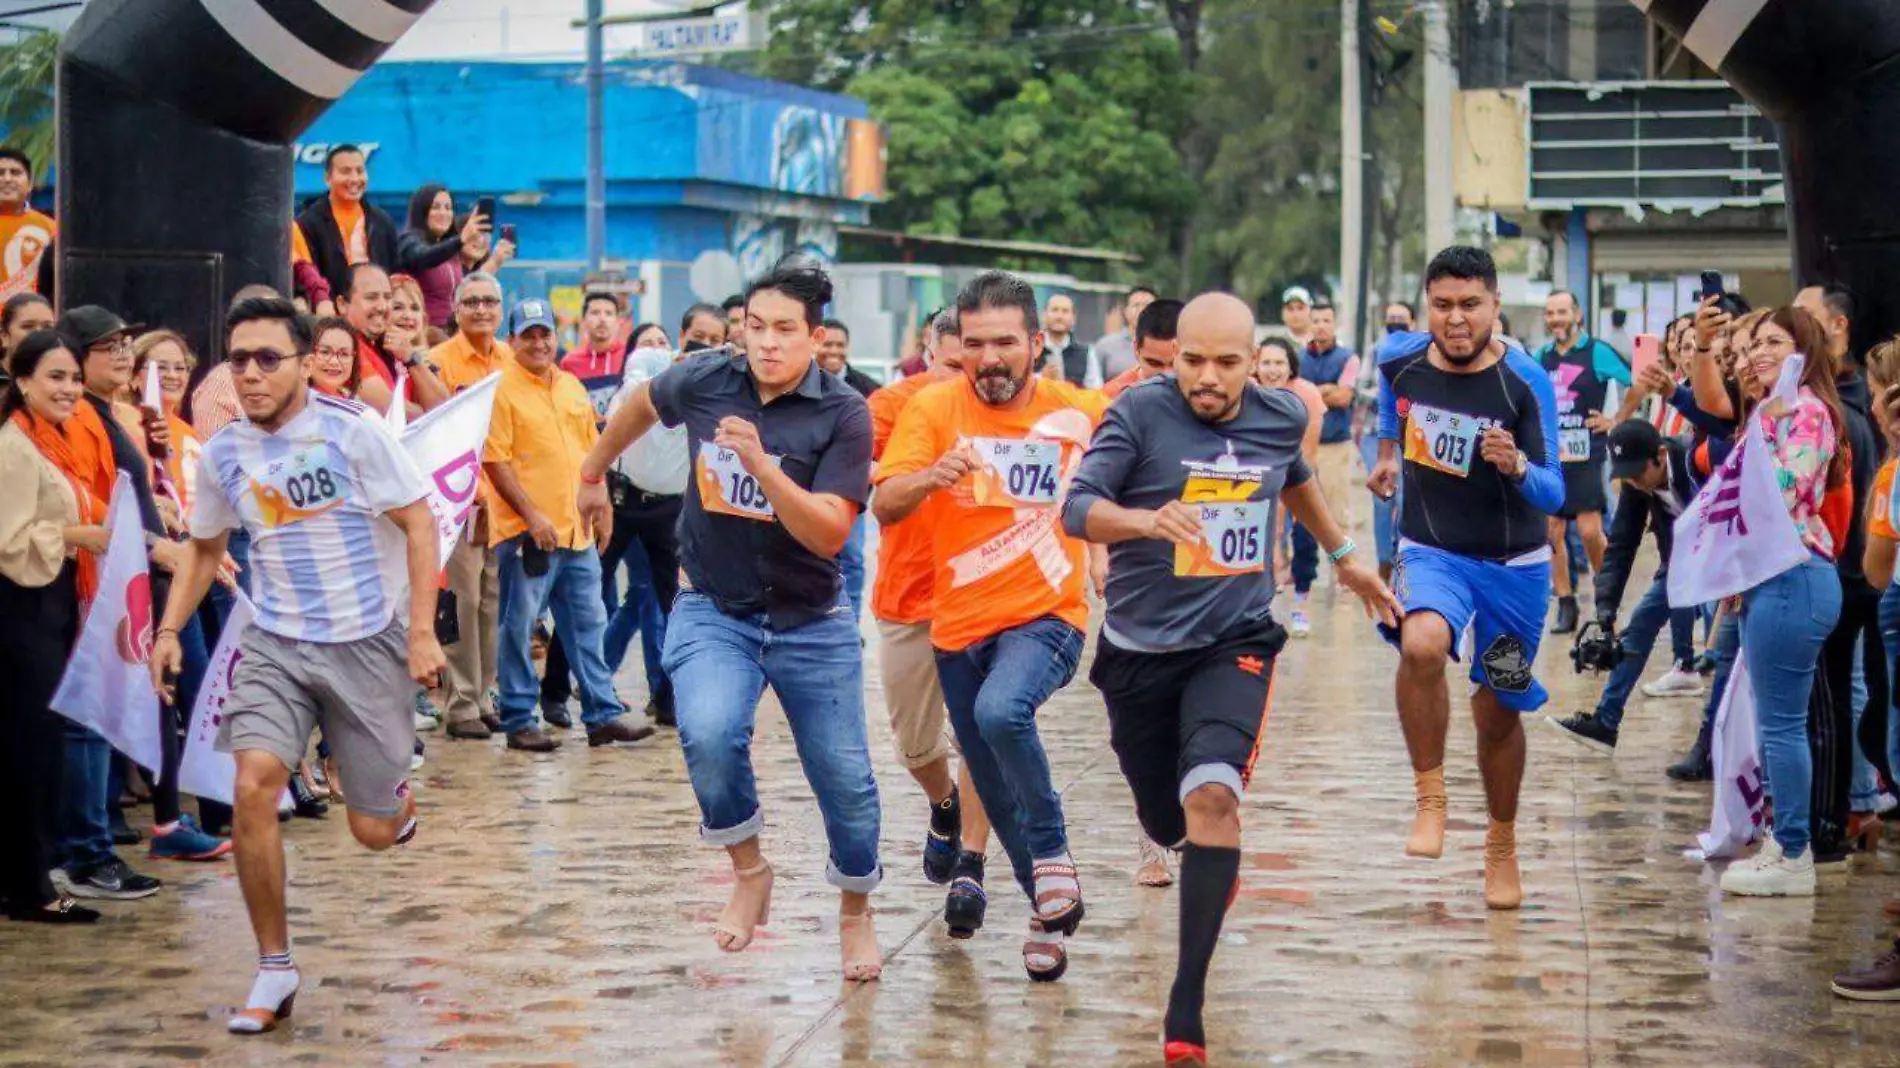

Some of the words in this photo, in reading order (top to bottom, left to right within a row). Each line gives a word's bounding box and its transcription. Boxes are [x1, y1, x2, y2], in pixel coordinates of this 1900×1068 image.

[1434, 431, 1467, 465] 013
[286, 466, 336, 508] 028
[1008, 462, 1056, 496] 074
[1221, 525, 1259, 563] 015
